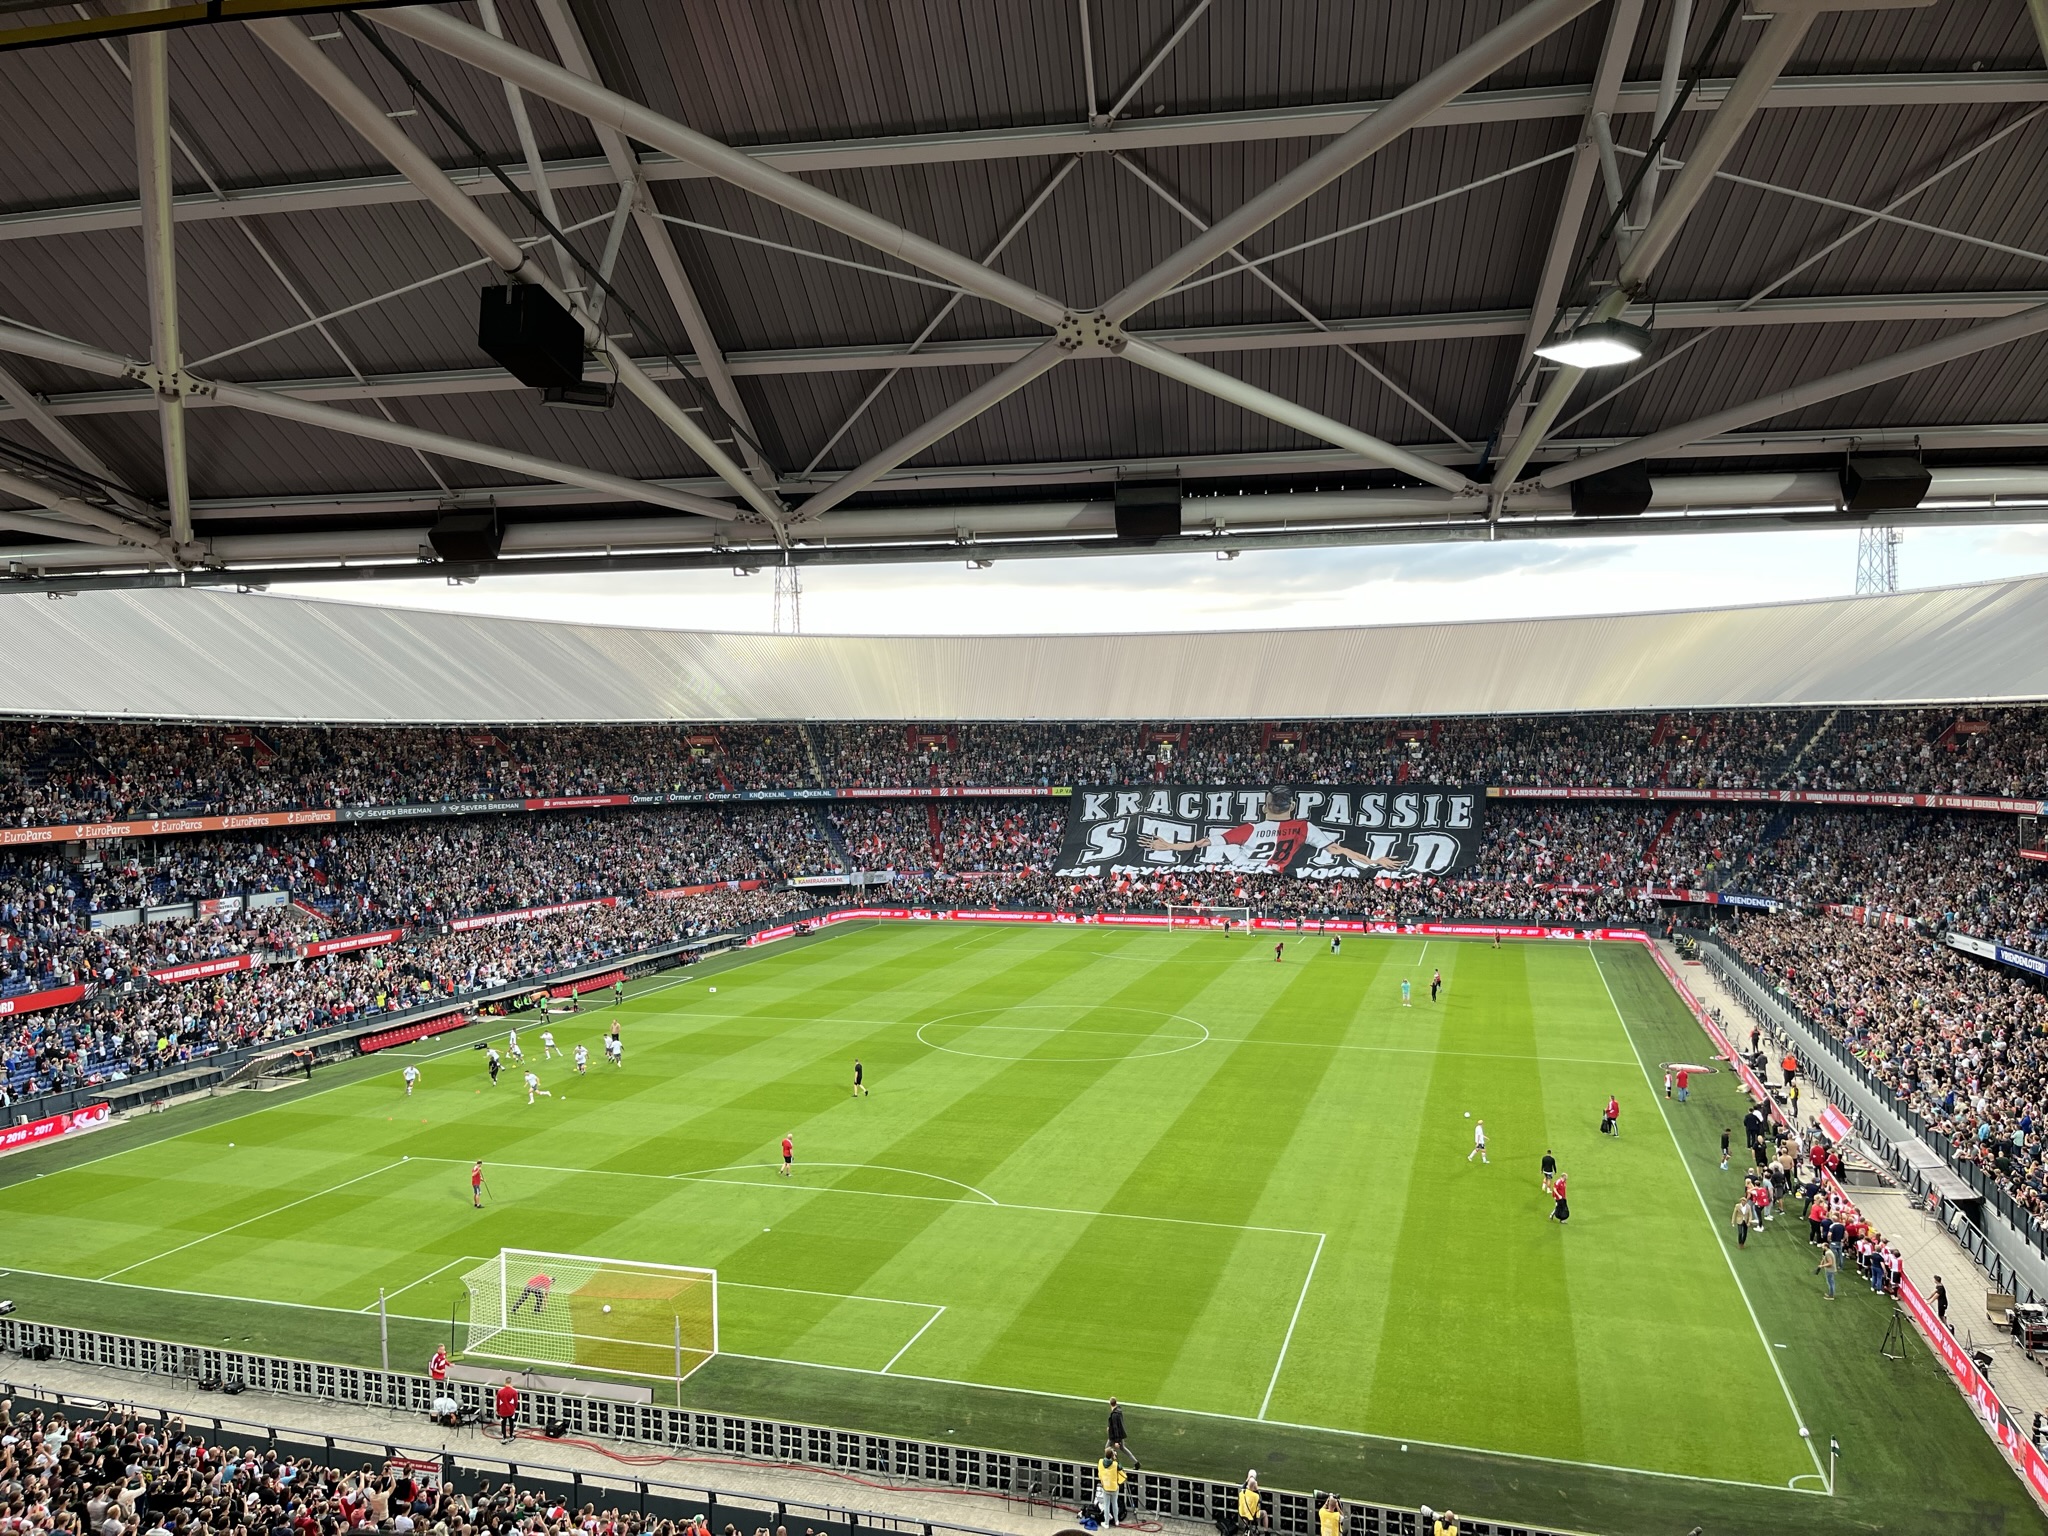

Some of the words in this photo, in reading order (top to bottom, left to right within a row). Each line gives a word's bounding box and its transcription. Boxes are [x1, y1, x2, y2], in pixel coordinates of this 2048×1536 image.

[750, 791, 786, 799] KNAKEN.NL
[794, 790, 832, 798] KNAKEN.NL
[1658, 790, 1711, 798] BEKERWINNAAR
[1806, 792, 1838, 800] WINNAAR
[1838, 794, 1854, 802] UEFA
[1856, 794, 1870, 802] CUP
[1871, 795, 1886, 803] 1974
[1898, 796, 1914, 804] 2002
[461, 804, 487, 812] SEVERS
[488, 802, 520, 810] BREEMAN
[1081, 791, 1270, 822] KRACHT
[1296, 792, 1474, 828] PASSIE
[1946, 798, 1960, 806] CLUB
[1961, 799, 1972, 808] VAN
[2000, 802, 2014, 810] VOOR
[295, 812, 331, 822] EuroParcs
[368, 808, 396, 817] SEVERS
[398, 807, 432, 816] BREEMAN
[162, 820, 202, 832] EuroParcs
[231, 818, 269, 828] EuroParcs
[4, 831, 52, 843] EuroParcs
[86, 826, 130, 837] EuroParcs
[1248, 839, 1294, 861] 28
[1296, 866, 1360, 879] VOOR
[452, 920, 468, 930] VOOR
[0, 1001, 14, 1014] RD
[6, 1130, 26, 1144] 2016
[35, 1122, 54, 1136] 2017
[1956, 1356, 1968, 1377] 2017
